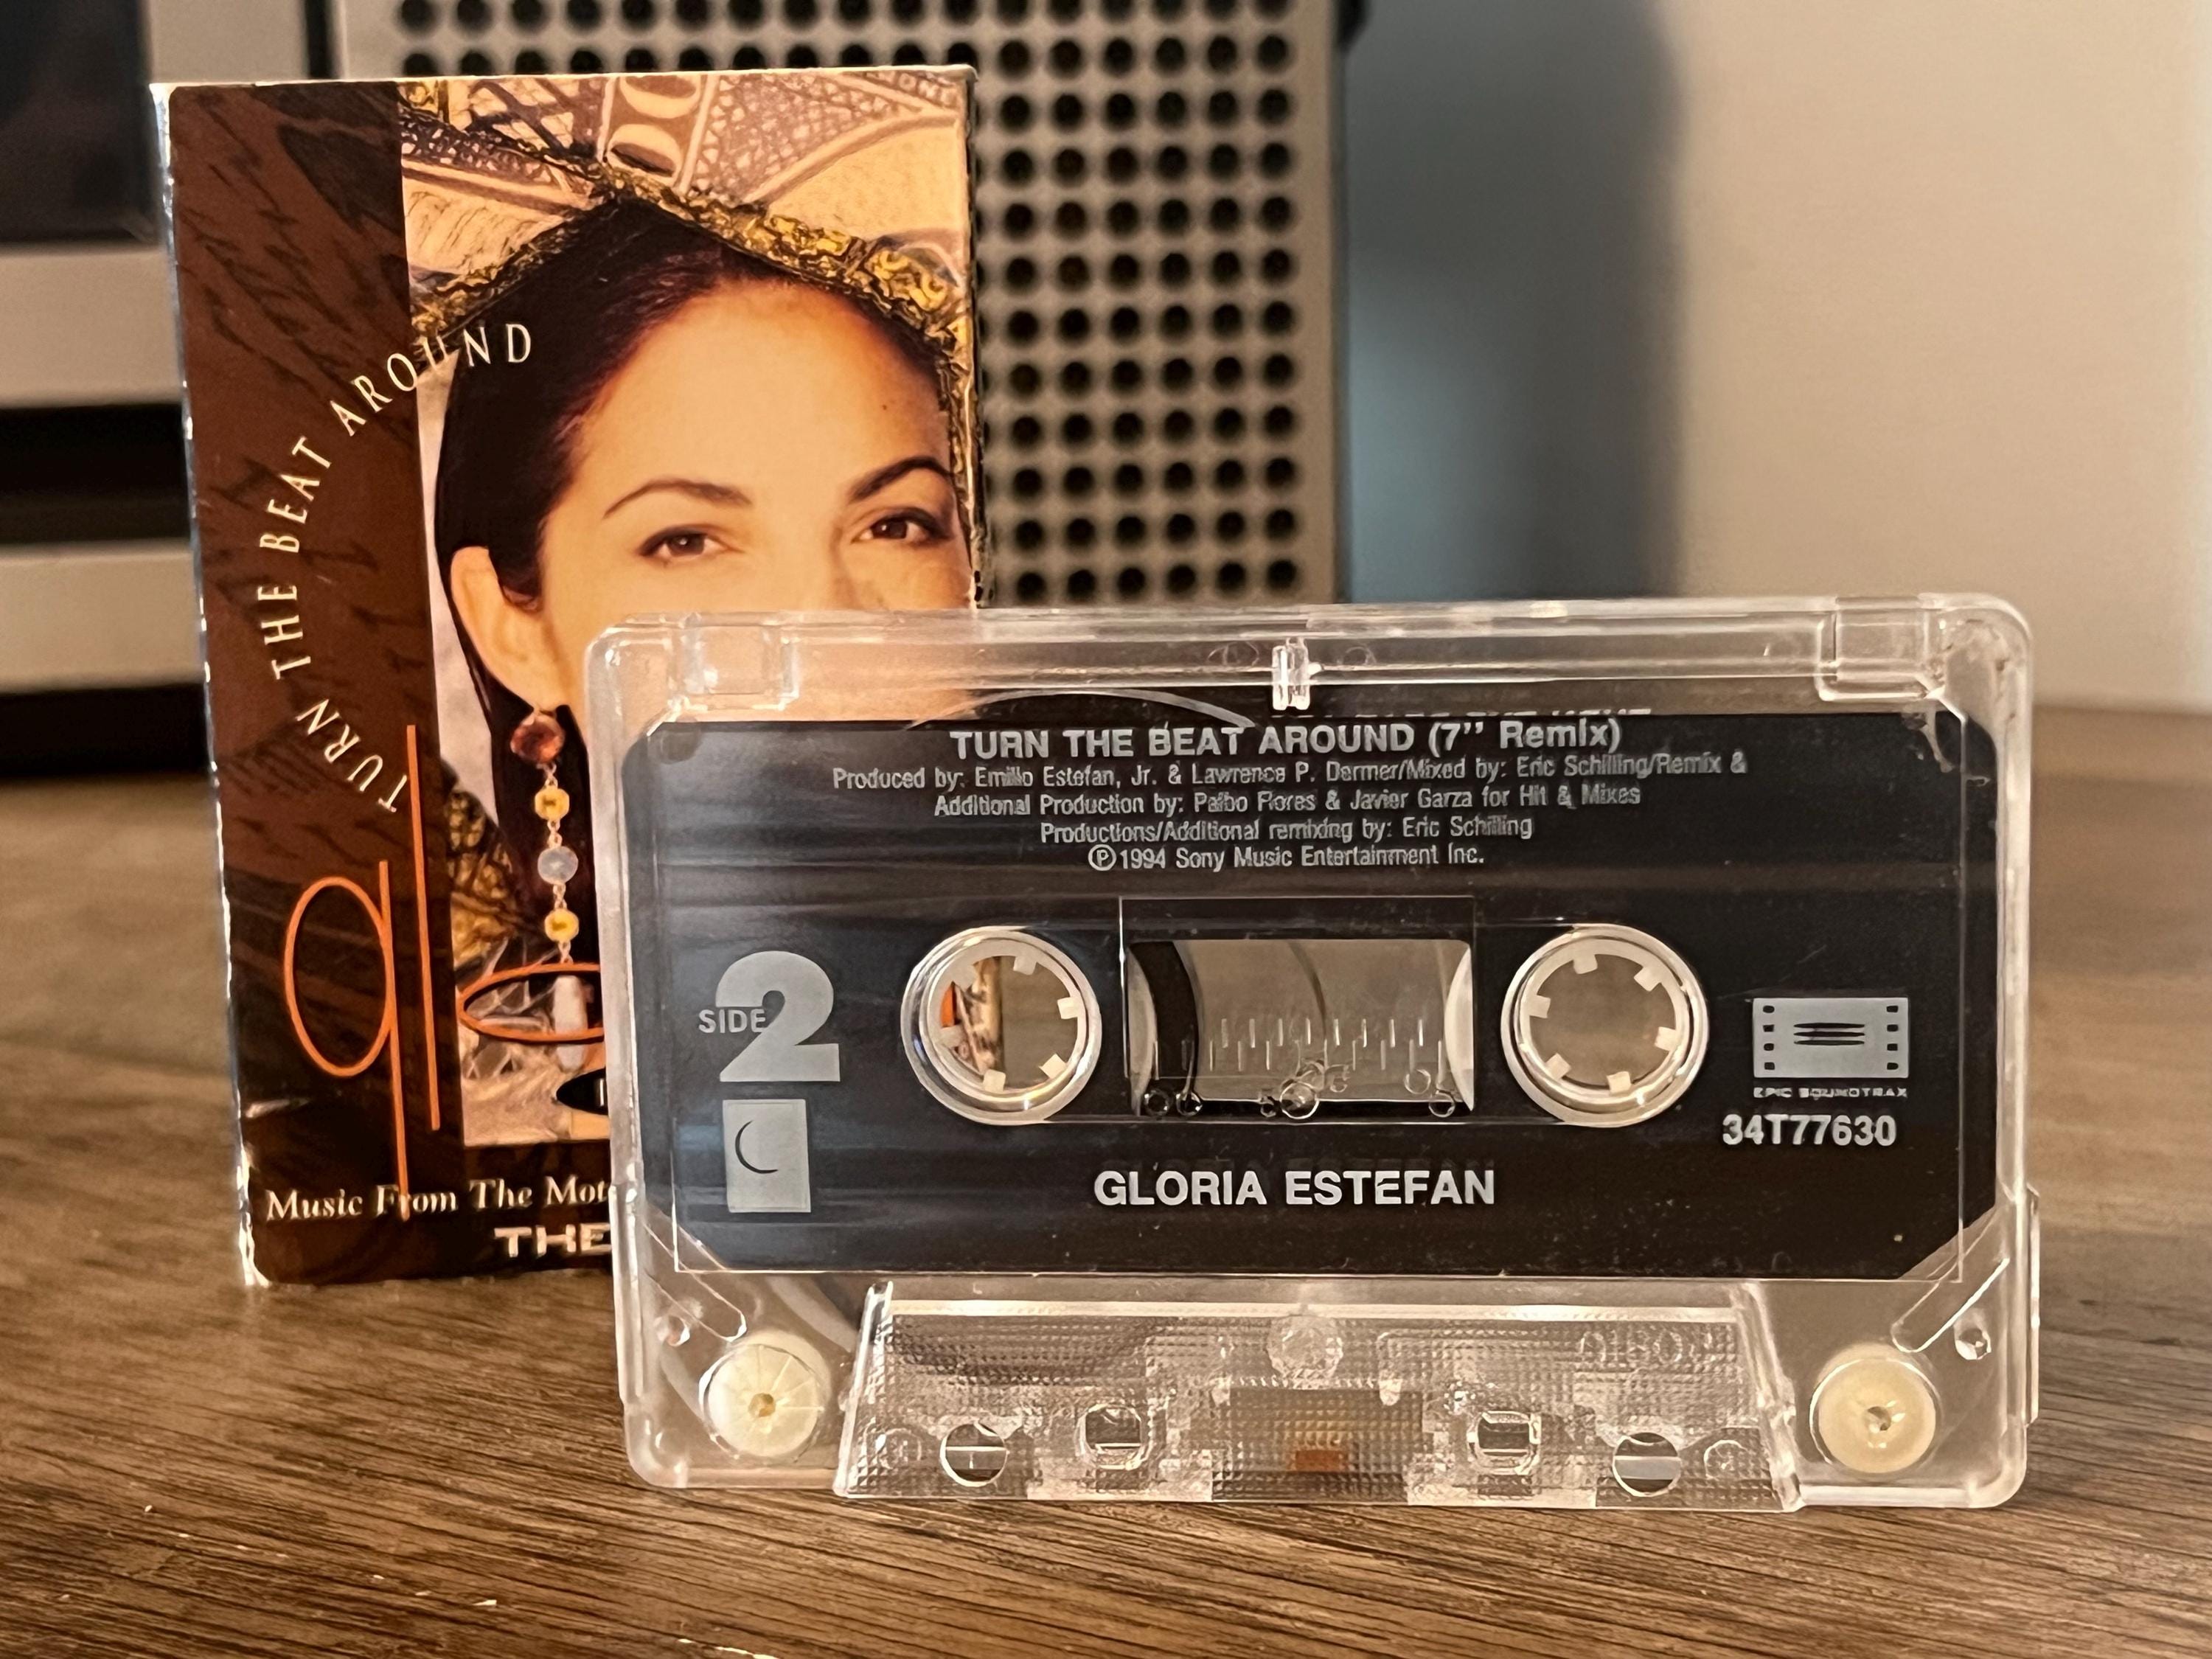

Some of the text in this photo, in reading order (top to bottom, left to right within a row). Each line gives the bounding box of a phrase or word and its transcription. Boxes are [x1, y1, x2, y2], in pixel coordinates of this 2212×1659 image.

[258, 322, 532, 814] TURN THE BEAT AROUND
[950, 728, 1049, 759] TURN
[1062, 728, 1134, 758] THE
[1148, 726, 1245, 757] BEAT
[1258, 723, 1416, 755] AROUND
[1500, 717, 1621, 754] Remix)
[832, 767, 926, 790] Produced
[934, 766, 964, 793] by:
[1043, 764, 1121, 789] Estefan,
[1131, 764, 1157, 786] Jr.
[1168, 762, 1183, 785] &
[1192, 762, 1286, 784] Lawrence
[1295, 761, 1315, 782] P.
[1475, 757, 1507, 783] by:
[1517, 754, 1556, 778] Eric
[1730, 748, 1747, 774] &
[933, 794, 1032, 816] Additional
[1040, 793, 1144, 815] Production
[1153, 792, 1184, 818] by:
[1325, 787, 1341, 810] &
[1349, 787, 1410, 810] Javier
[1417, 786, 1473, 809] Garza
[1481, 785, 1511, 807] for
[1520, 783, 1548, 807] Hit
[1557, 783, 1577, 809] &
[1581, 782, 1641, 805] Mixes
[1040, 817, 1260, 844] Productions/Additional
[1362, 816, 1393, 843] by:
[1402, 815, 1439, 838] Eric
[1450, 813, 1534, 840] Schilling
[1175, 846, 1225, 872] Sony
[1233, 845, 1293, 868] Music
[1300, 844, 1439, 867] Entertainment
[1447, 841, 1485, 865] Inc.
[698, 950, 841, 1082] SIDE 2
[1722, 1113, 1898, 1147] 34T77630
[265, 1188, 364, 1222] Music
[470, 1178, 533, 1210] The
[1093, 1169, 1496, 1206] GLORIA ESTEFAN
